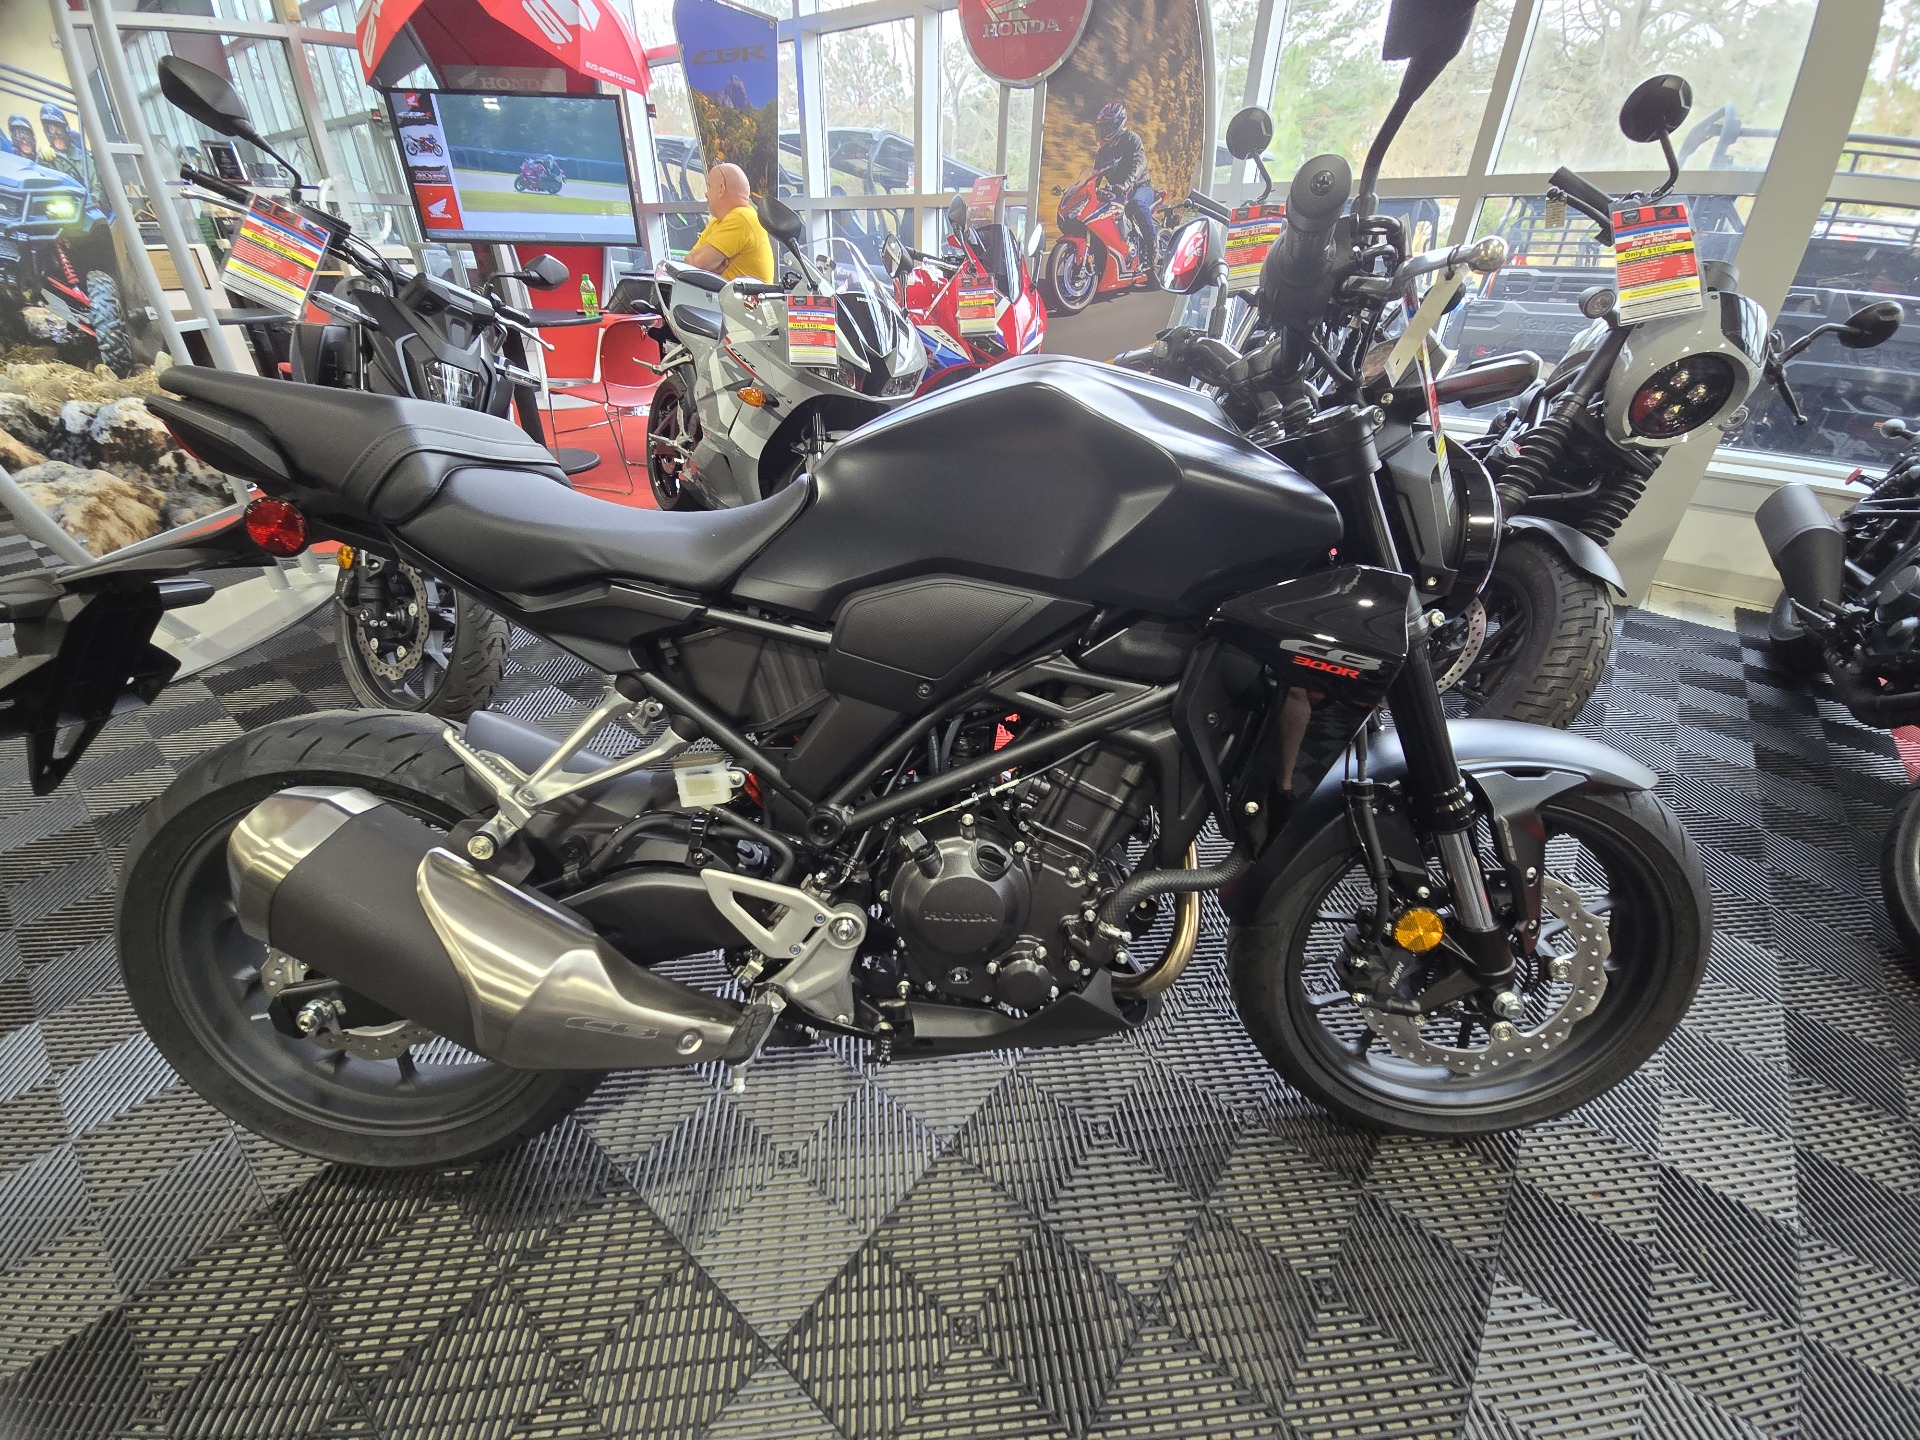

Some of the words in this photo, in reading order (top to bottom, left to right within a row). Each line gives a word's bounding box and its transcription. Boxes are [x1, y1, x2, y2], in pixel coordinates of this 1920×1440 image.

[982, 18, 1062, 38] HONDA
[691, 45, 770, 66] CBR
[479, 76, 558, 91] HONDA
[251, 233, 271, 246] Only:
[1652, 233, 1677, 243] Rebel!
[1624, 249, 1646, 259] Only:
[730, 347, 757, 372] CBR
[1280, 639, 1382, 670] CB
[1291, 655, 1360, 679] 300R
[924, 910, 998, 922] HONDA
